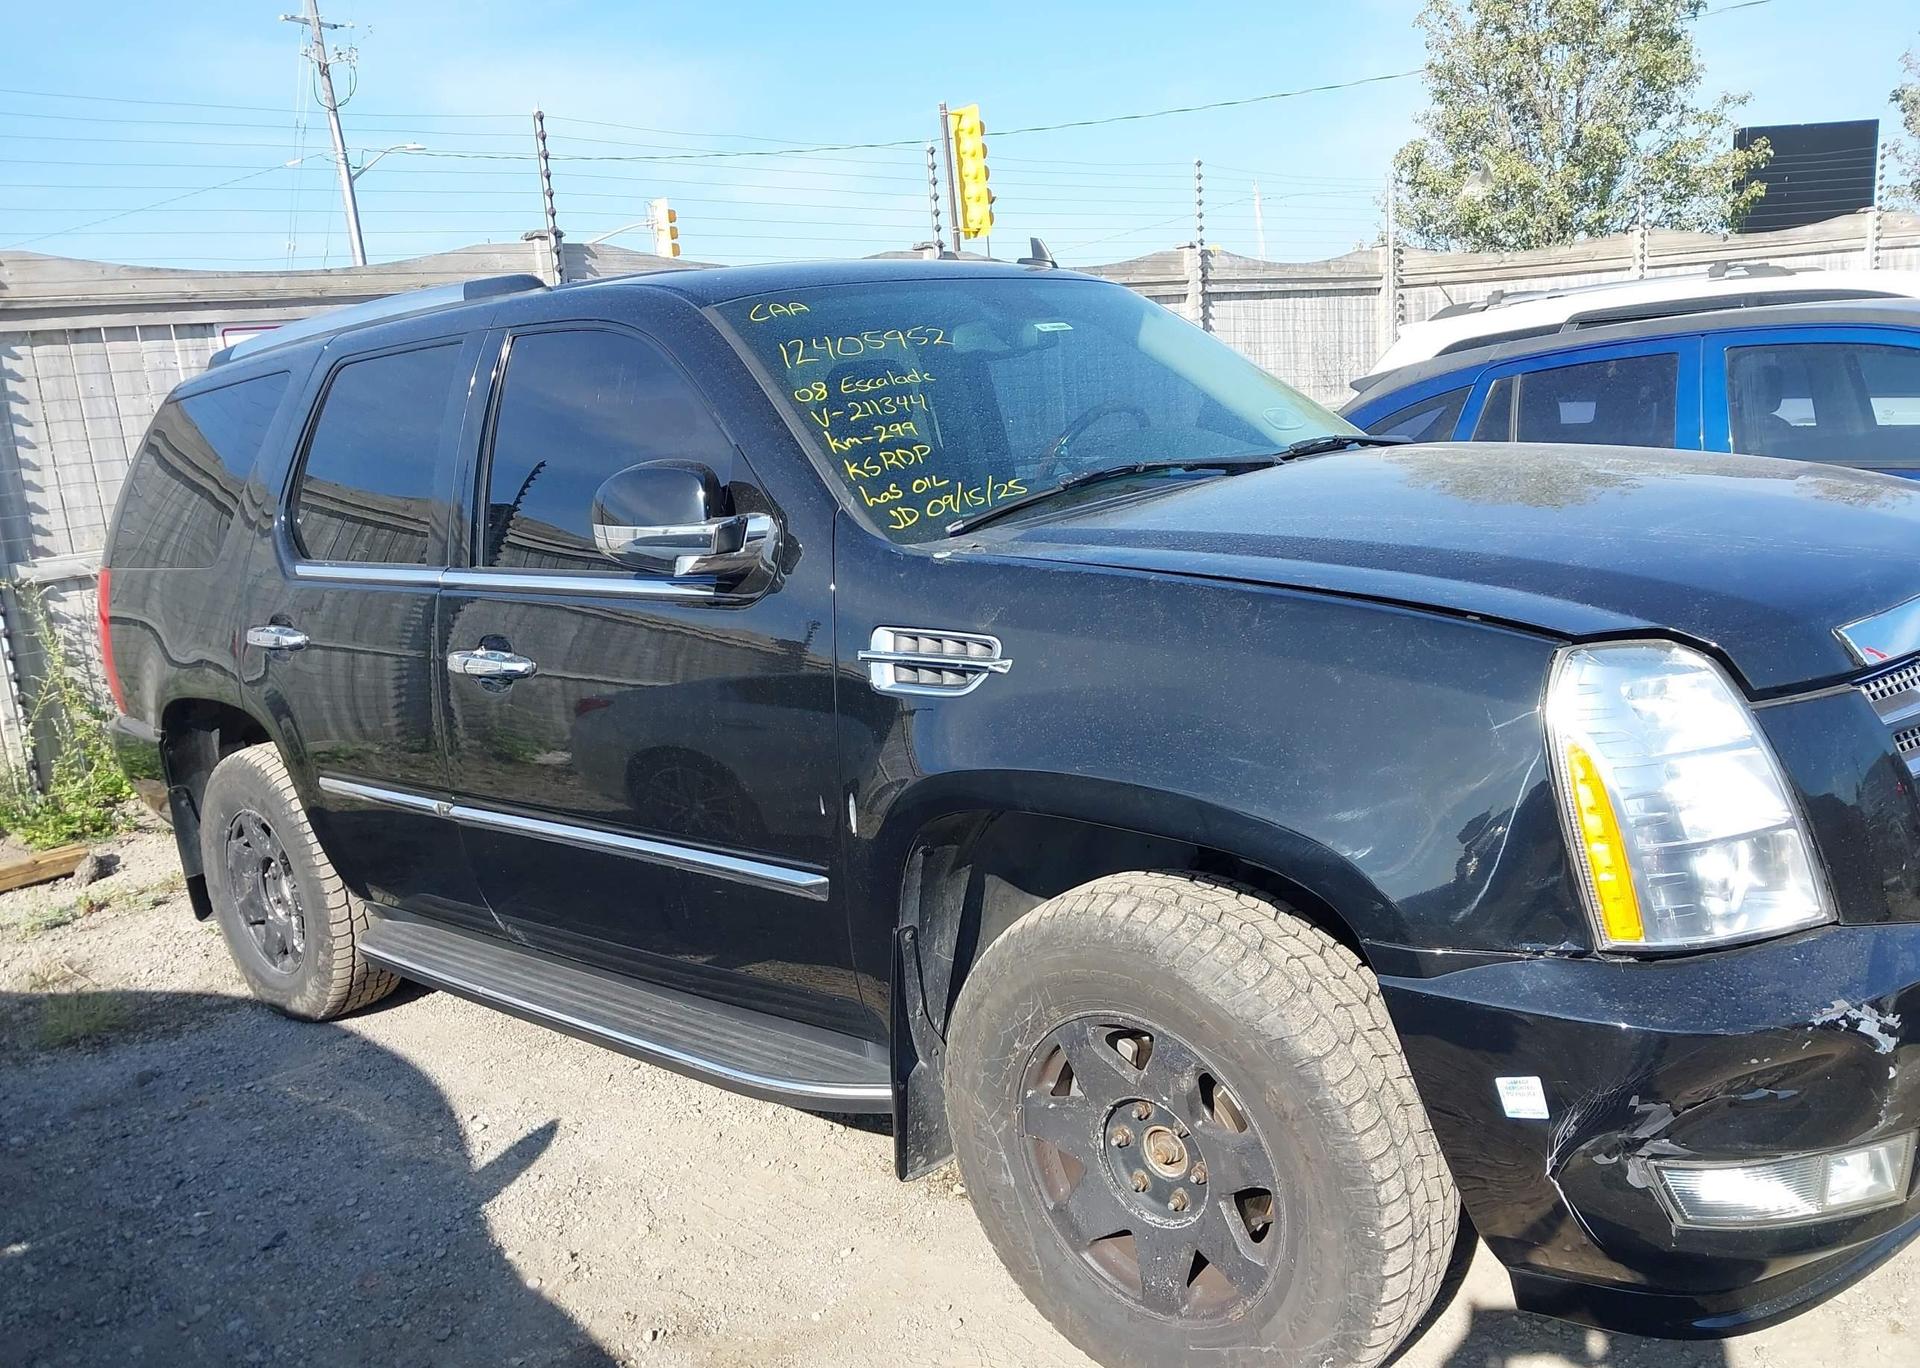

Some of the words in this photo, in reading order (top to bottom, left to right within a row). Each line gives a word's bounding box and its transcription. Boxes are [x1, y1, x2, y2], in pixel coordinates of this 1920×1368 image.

[749, 301, 810, 322] CAA
[779, 326, 956, 369] 12405952
[794, 382, 828, 402] 08
[840, 368, 937, 394] Escalade
[926, 475, 1028, 518] 09/15/25
